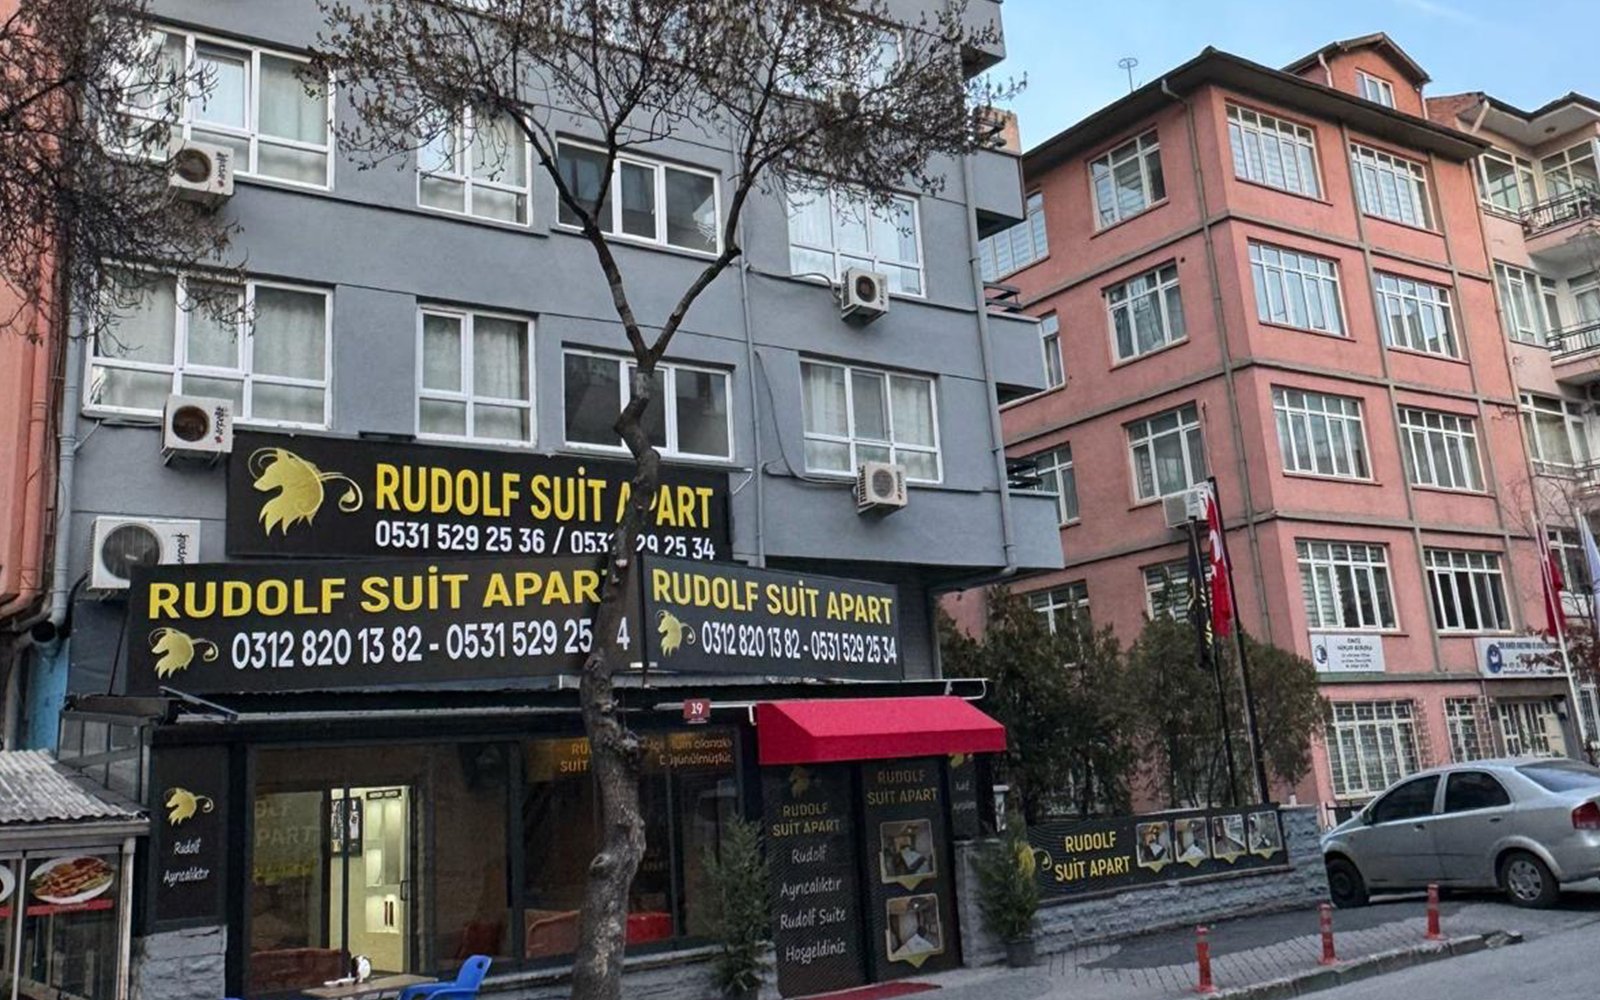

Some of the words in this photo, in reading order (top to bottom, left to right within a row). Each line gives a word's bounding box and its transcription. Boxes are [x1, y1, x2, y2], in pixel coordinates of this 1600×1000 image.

[375, 462, 521, 518] RUDOLF
[530, 465, 607, 523] SUİT
[616, 482, 713, 529] AART
[375, 519, 429, 549] 0531
[438, 524, 478, 551] 529
[486, 526, 512, 553] 25
[519, 527, 545, 554] 36
[552, 525, 564, 554] /
[636, 533, 659, 554] 29
[664, 535, 687, 557] 25
[692, 537, 715, 560] 34
[148, 576, 347, 620] RUDOLF
[360, 566, 470, 613] SUİT
[482, 569, 607, 608] APAR
[652, 568, 759, 612] RUDOLF
[766, 580, 820, 618] SUİT
[826, 591, 893, 625] APART
[231, 631, 295, 670] 0312
[302, 627, 352, 666] 820
[358, 626, 385, 664] 13
[392, 625, 422, 663] 82
[429, 642, 439, 651] -
[447, 622, 506, 660] 0531
[512, 619, 558, 657] 529
[564, 617, 594, 654] 25
[702, 620, 737, 656] 0312
[739, 624, 765, 658] 820
[767, 626, 782, 659] 13
[784, 629, 801, 660] 82
[811, 630, 842, 662] 0531
[843, 633, 864, 663] 529
[867, 636, 881, 664] 25
[882, 636, 897, 665] 34
[691, 702, 703, 715] 19
[877, 769, 926, 783] RUDOLF
[899, 787, 938, 802] APART
[783, 802, 828, 818] RUDOLF
[803, 819, 840, 835] APART
[1065, 831, 1117, 853] RUDOLF
[791, 844, 827, 865] Rudolf
[1054, 857, 1085, 882] SUİT
[1089, 855, 1130, 877] APART
[780, 910, 816, 930] Rudolf
[819, 907, 846, 925] Suite
